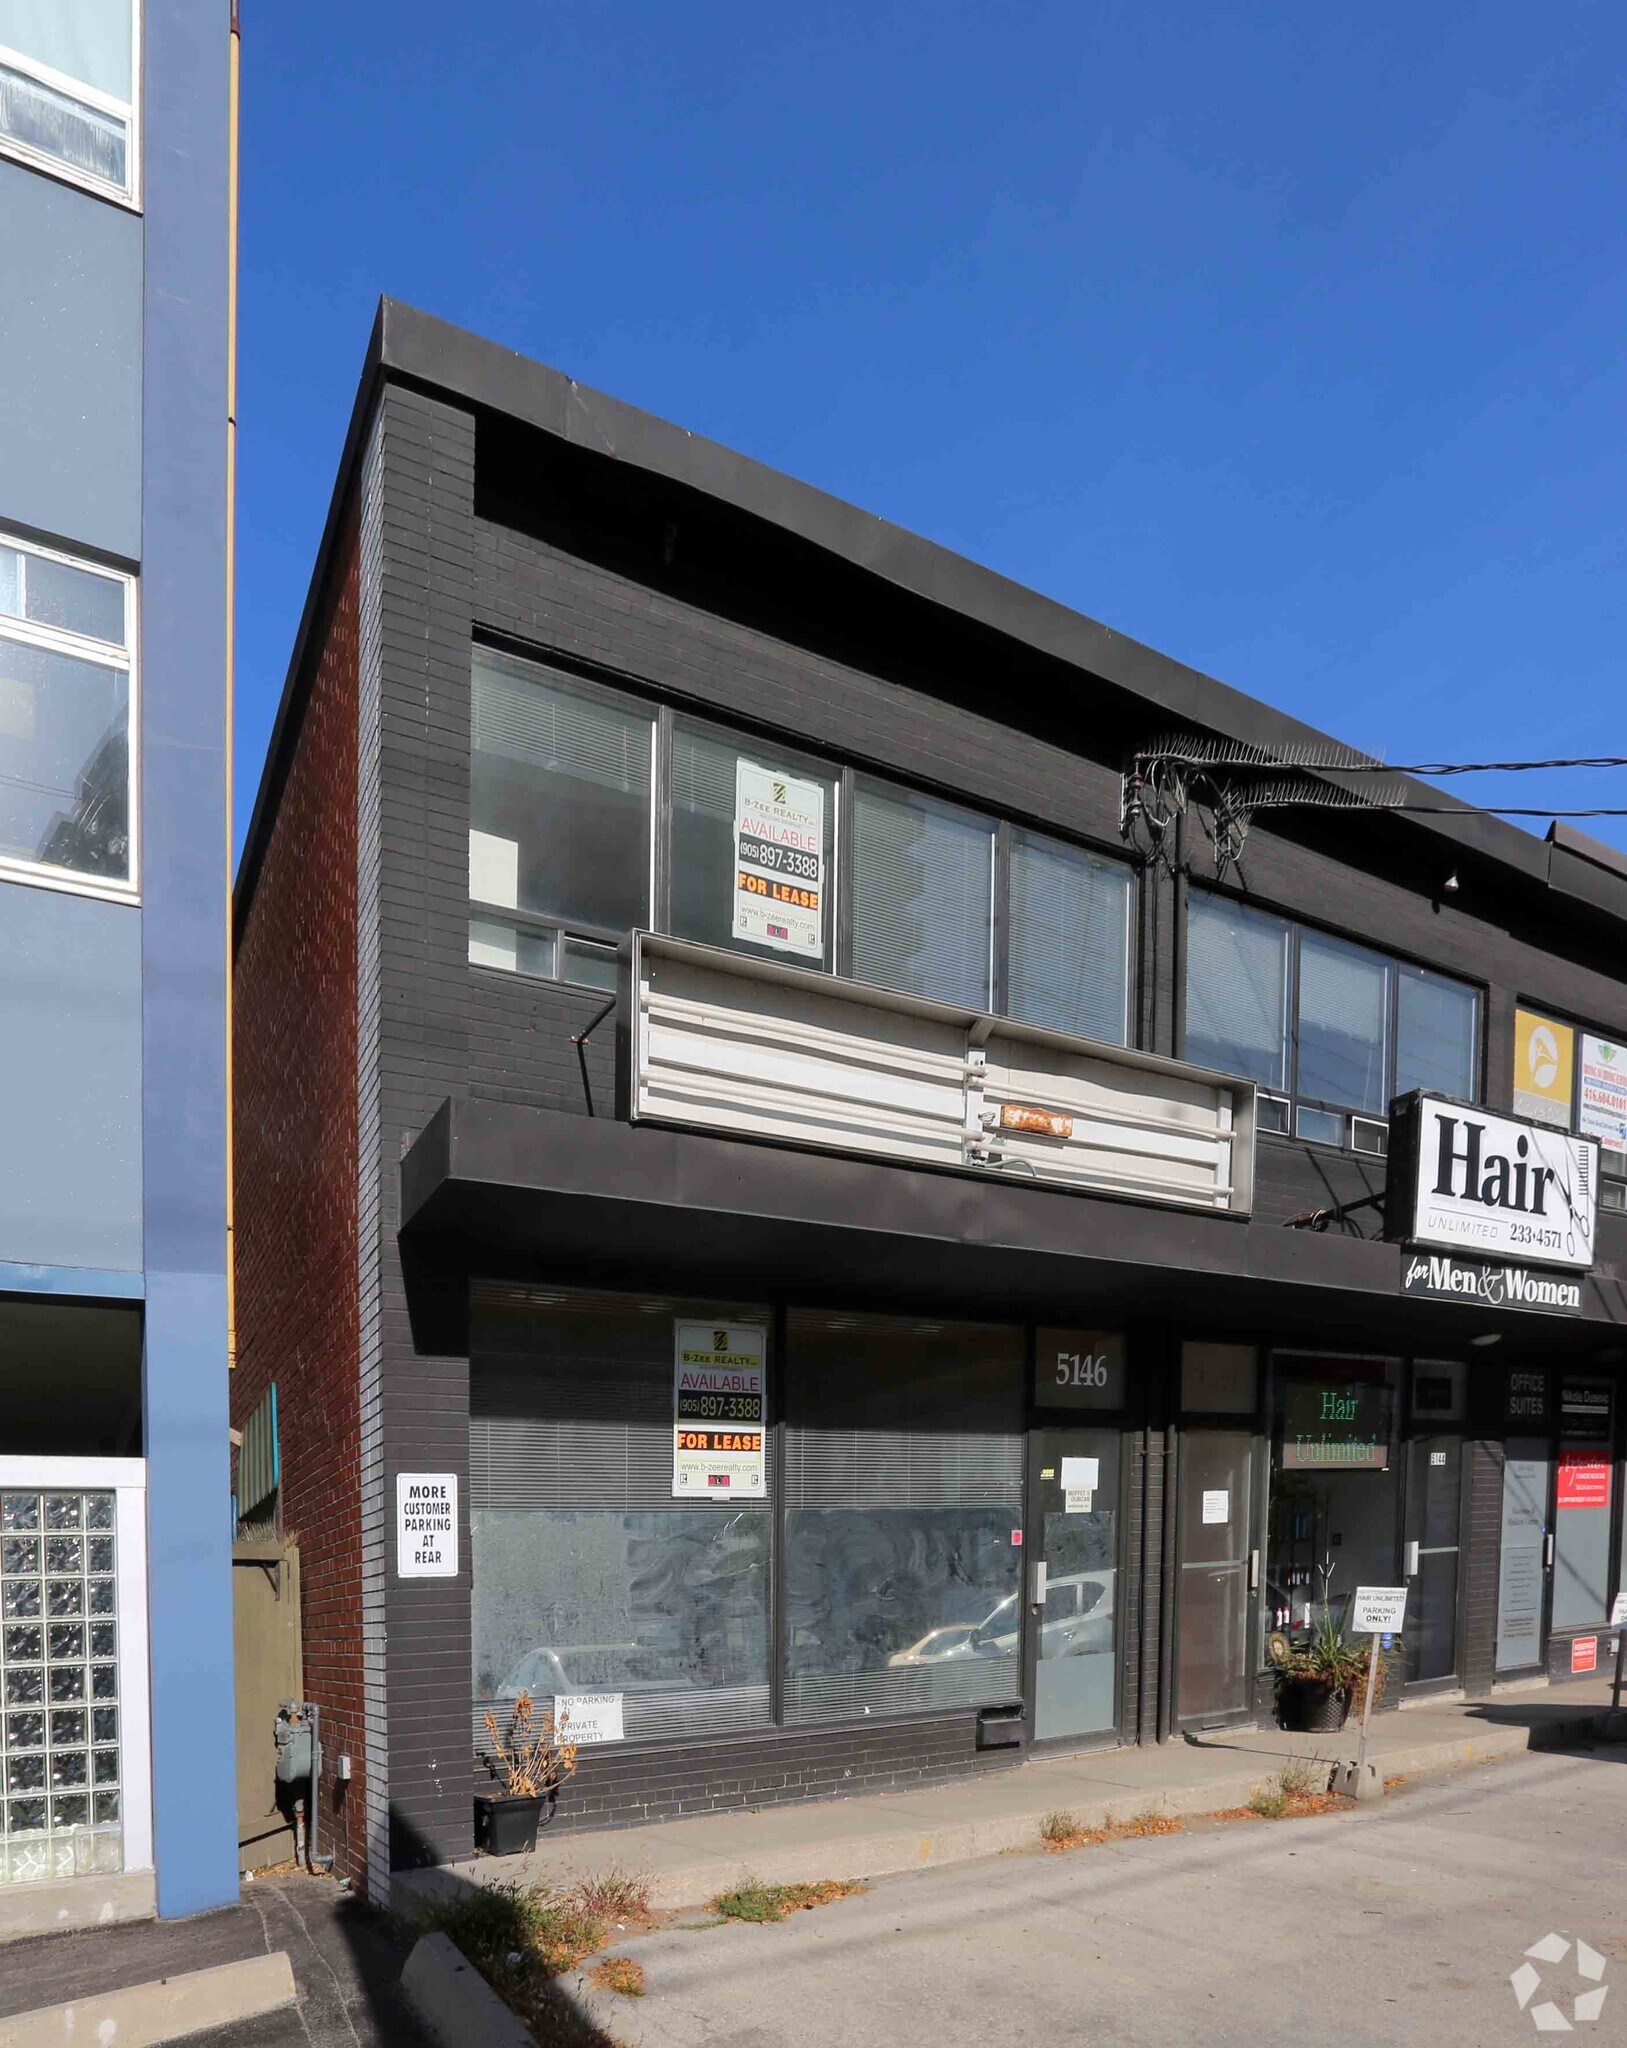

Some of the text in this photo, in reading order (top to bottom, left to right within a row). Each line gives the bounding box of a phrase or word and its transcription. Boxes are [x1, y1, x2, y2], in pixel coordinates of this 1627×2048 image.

[773, 807, 809, 825] REALTY
[741, 817, 816, 851] AVAILABLE
[759, 844, 818, 879] 897-3388
[739, 872, 818, 909] FOR LEASE
[741, 906, 815, 931] www.b-zeerealty.com
[1431, 1114, 1555, 1216] Hair
[1428, 1216, 1499, 1238] UNLIMITED
[1405, 1256, 1580, 1307] for Men & Women
[714, 1355, 750, 1365] REALTY
[1056, 1353, 1108, 1387] 5146
[680, 1373, 760, 1392] AVAILABLE
[1510, 1373, 1544, 1391] OFFICE
[700, 1396, 760, 1419] 897-3388
[1320, 1392, 1360, 1420] Hair
[1510, 1397, 1543, 1414] SUITES
[678, 1433, 761, 1450] FOR LEASE
[1296, 1433, 1377, 1462] Unlimited
[681, 1462, 758, 1473] www.b-zeerealty.com
[409, 1486, 446, 1498] MORE
[404, 1503, 450, 1515] CUSTOMER
[404, 1518, 451, 1531] PARKING
[422, 1535, 434, 1547] AT
[414, 1551, 442, 1564] REAR
[561, 1695, 614, 1707] NO PARKING
[562, 1721, 598, 1731] PRIVATE
